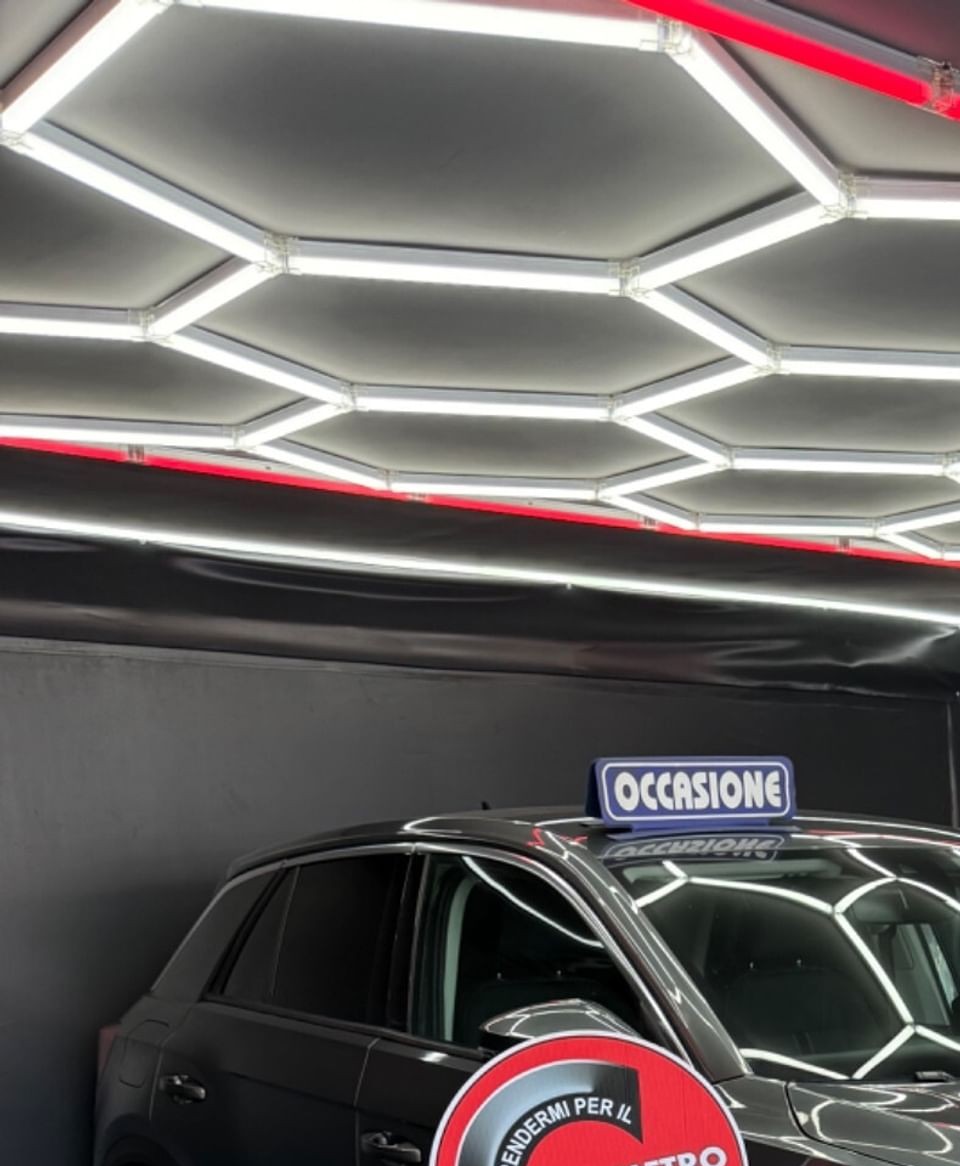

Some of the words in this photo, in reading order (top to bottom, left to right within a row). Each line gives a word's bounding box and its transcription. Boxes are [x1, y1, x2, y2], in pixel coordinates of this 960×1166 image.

[614, 770, 782, 811] OCCASIONE
[574, 1097, 614, 1116] PER
[616, 1103, 632, 1125] IL
